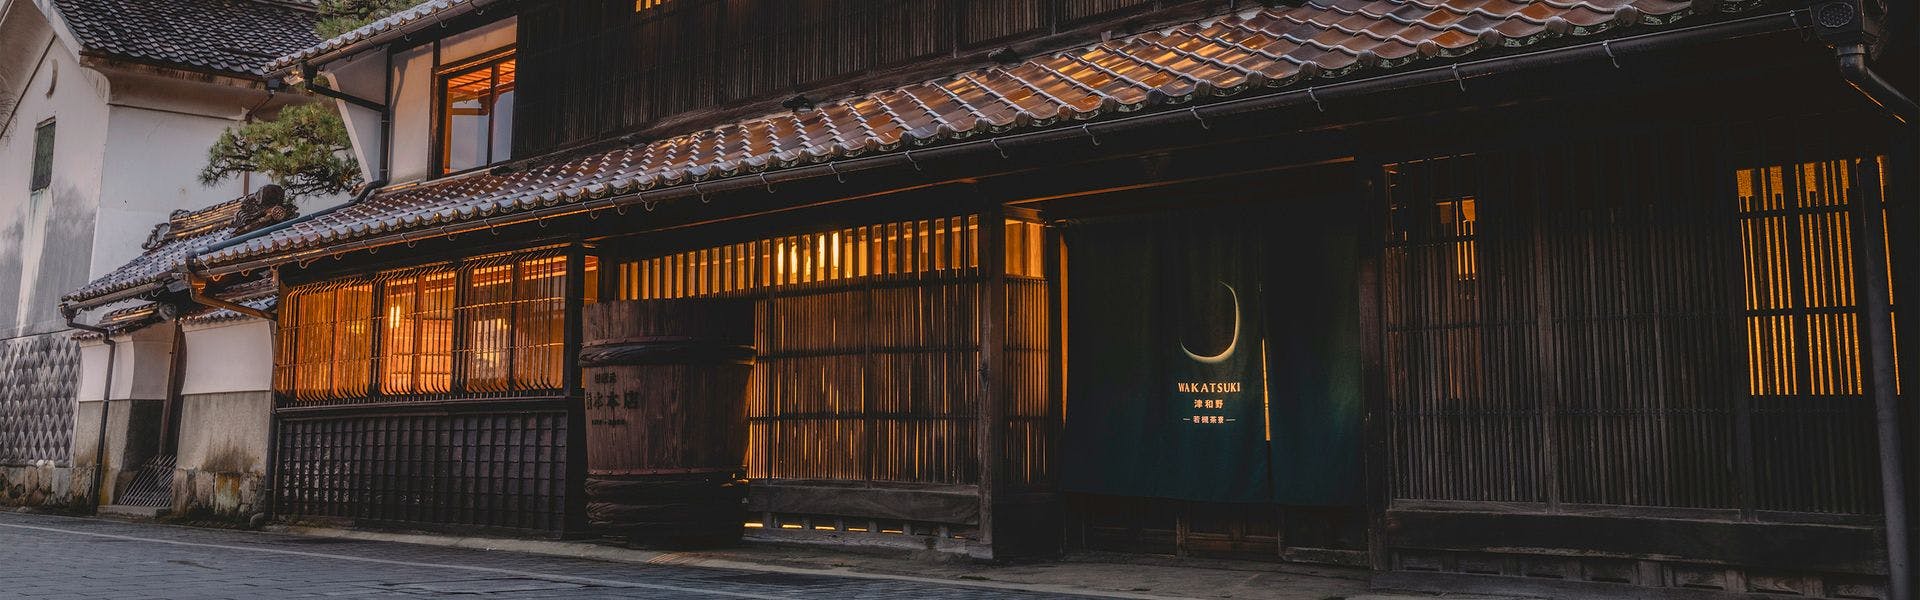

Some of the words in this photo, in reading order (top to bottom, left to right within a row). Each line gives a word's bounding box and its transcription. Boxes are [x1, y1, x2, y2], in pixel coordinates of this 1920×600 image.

[1178, 382, 1240, 393] WAKATSUKI
[1194, 399, 1224, 409] 津和野
